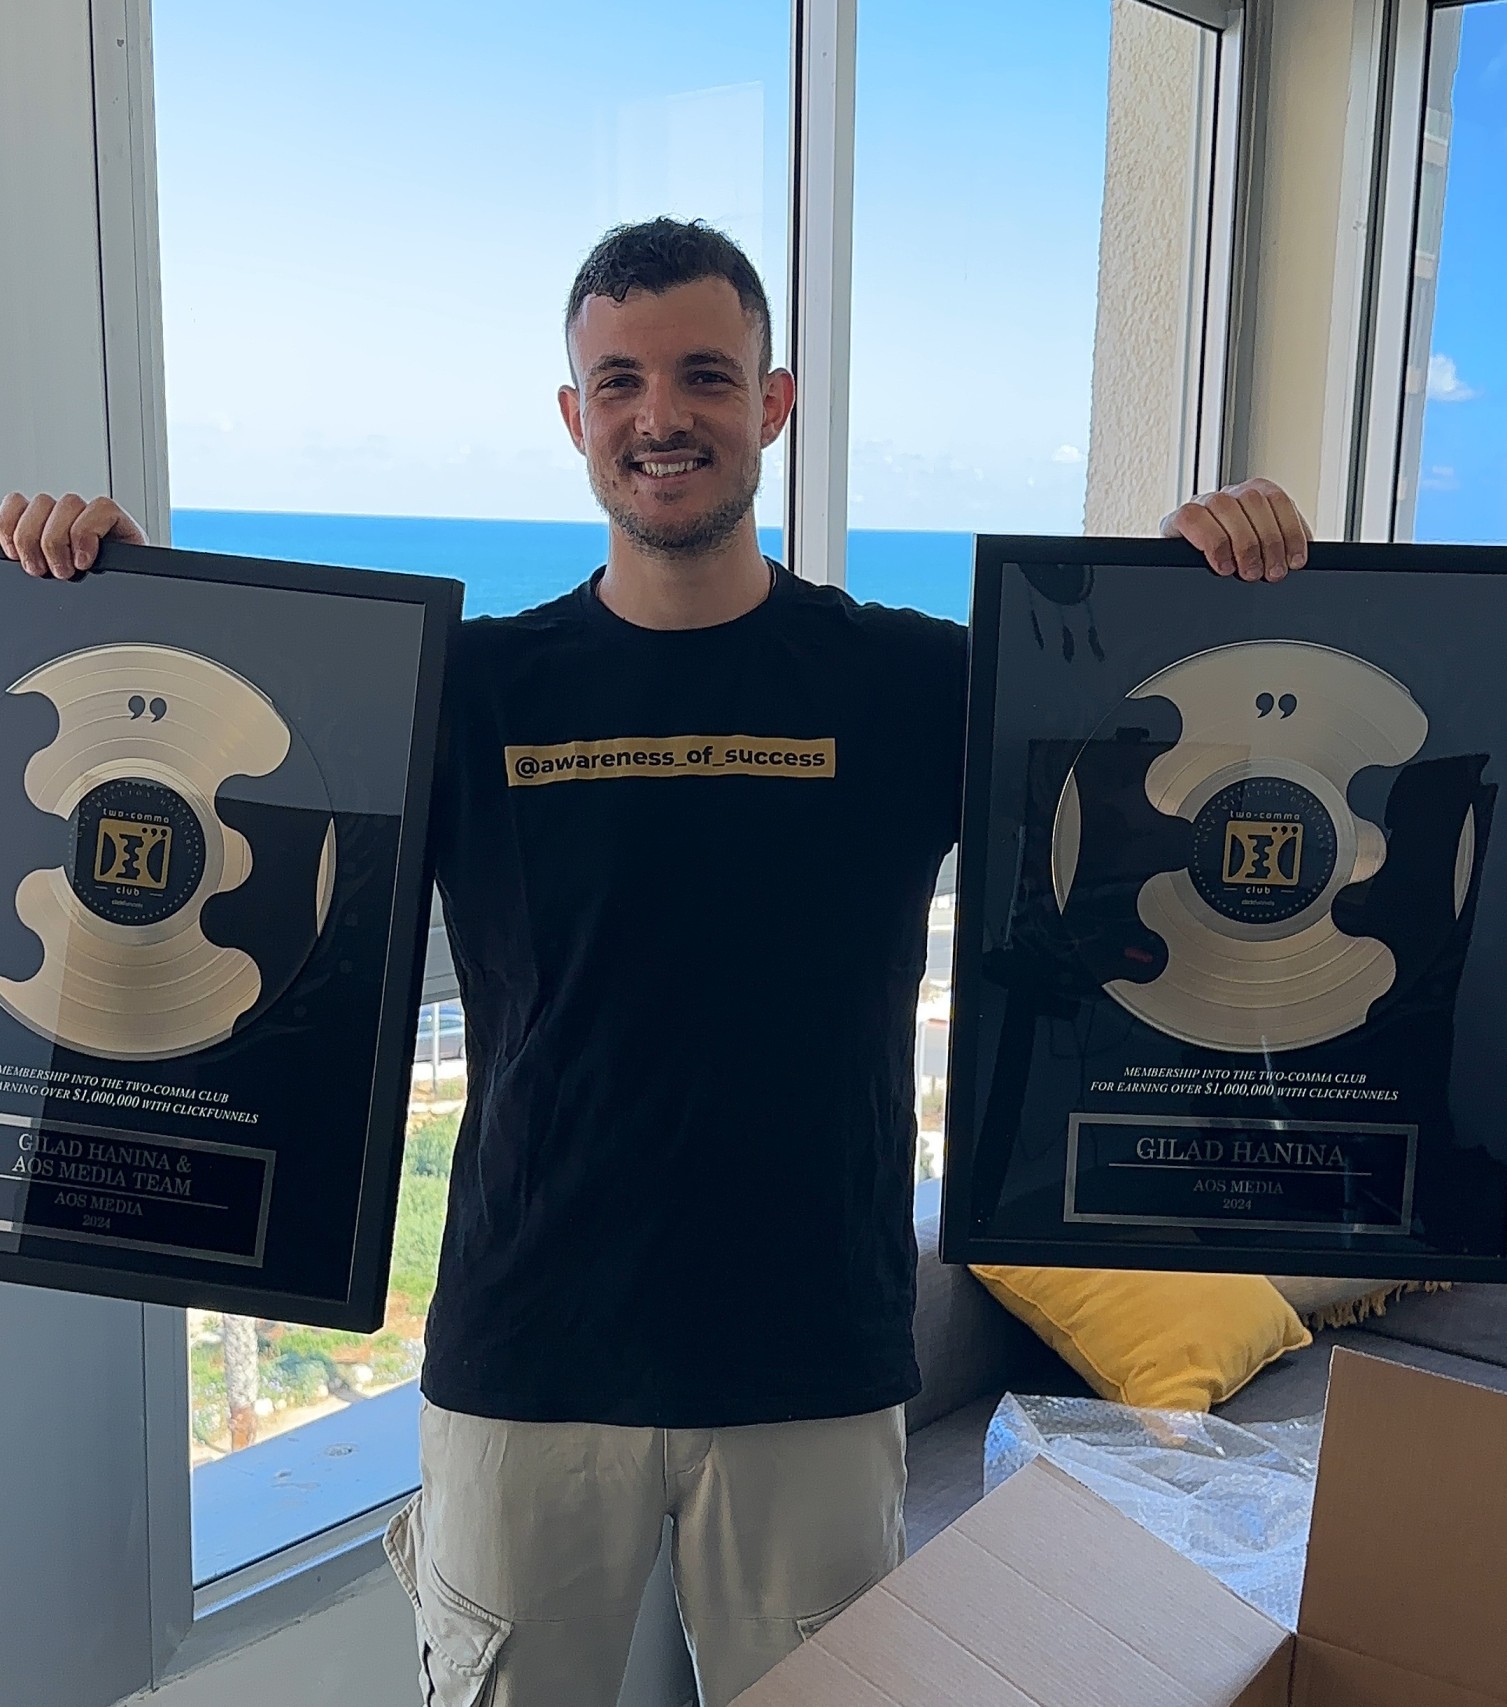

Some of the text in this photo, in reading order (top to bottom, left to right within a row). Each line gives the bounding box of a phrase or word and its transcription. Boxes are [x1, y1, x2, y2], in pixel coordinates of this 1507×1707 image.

[514, 745, 826, 779] @awareness_of_success
[1230, 810, 1300, 820] two-comma
[115, 885, 140, 896] club
[1245, 885, 1271, 895] club
[0, 1064, 230, 1104] MEMBERSHIP INTO THE TWO-COMMA CLUB
[1123, 1066, 1367, 1084] MEMBERSHIP INTO THE TWO-COMMA CLUB
[1090, 1081, 1399, 1101] FOR EARNING OVER $1,000,000 WITH CLICKFUNNELS
[0, 1081, 260, 1124] RNING OVER $1,000,000 WITH CLICKFUNNELS
[18, 1133, 192, 1174] GILAD HANINA &
[1136, 1137, 1348, 1167] GILAD HANINA
[11, 1155, 193, 1196] AOS MEDIA TEAM
[1193, 1178, 1284, 1195] AOS MEDIA
[54, 1191, 144, 1216] AOS MEDIA
[1223, 1198, 1252, 1210] 2024
[82, 1214, 112, 1229] 2024
